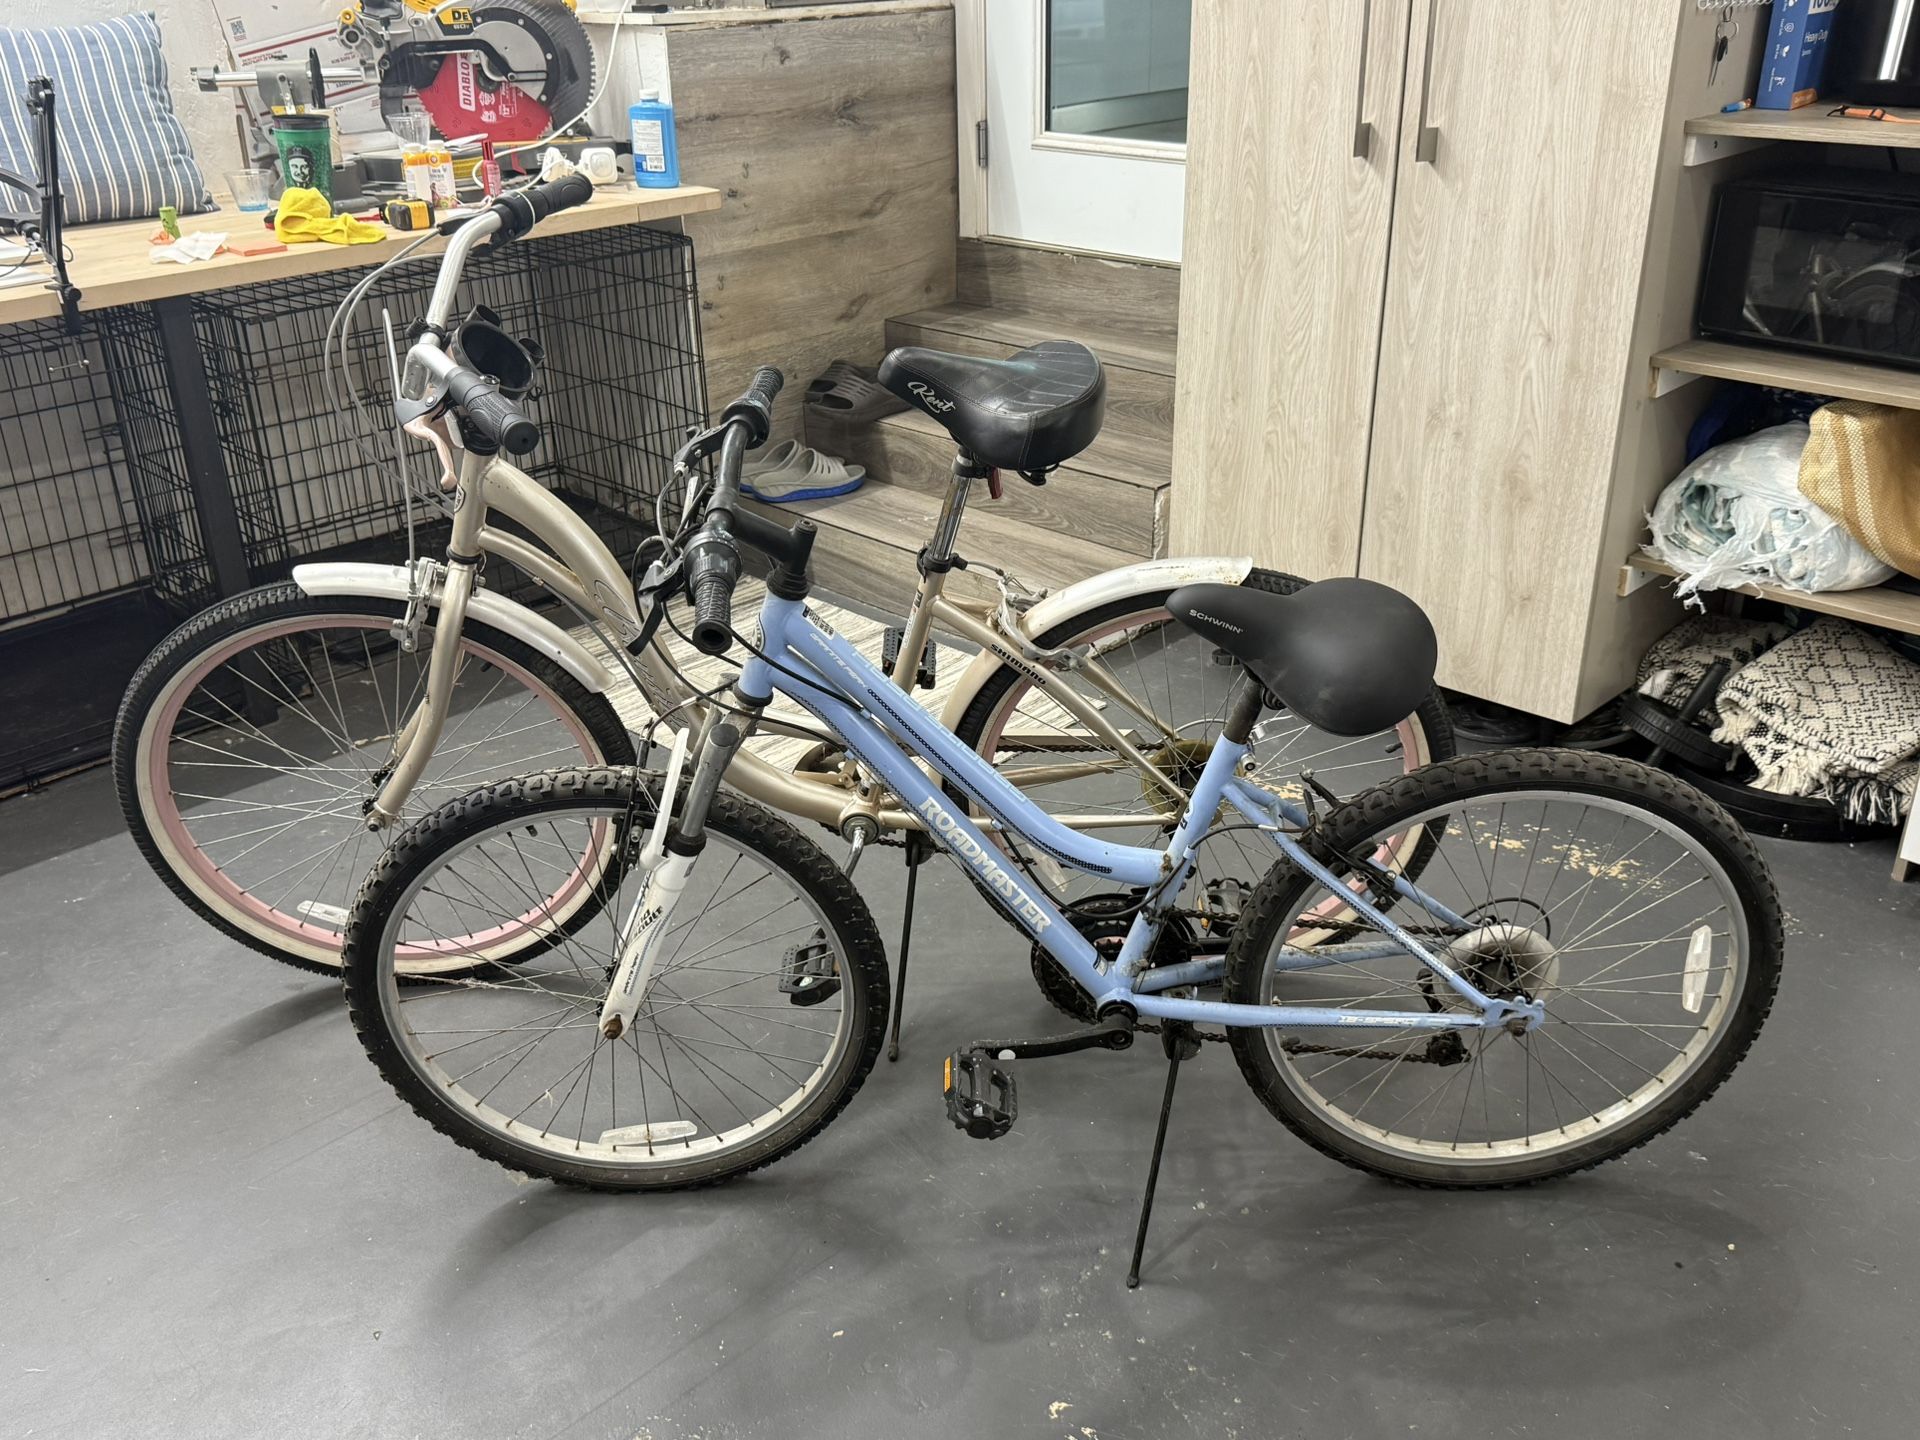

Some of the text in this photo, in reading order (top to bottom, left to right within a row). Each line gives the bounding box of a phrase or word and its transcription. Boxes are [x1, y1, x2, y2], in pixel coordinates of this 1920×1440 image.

[460, 62, 472, 106] DIABLO
[907, 381, 956, 414] Kent
[1189, 608, 1241, 634] SCHWINN
[919, 796, 1052, 934] ROADMASTER
